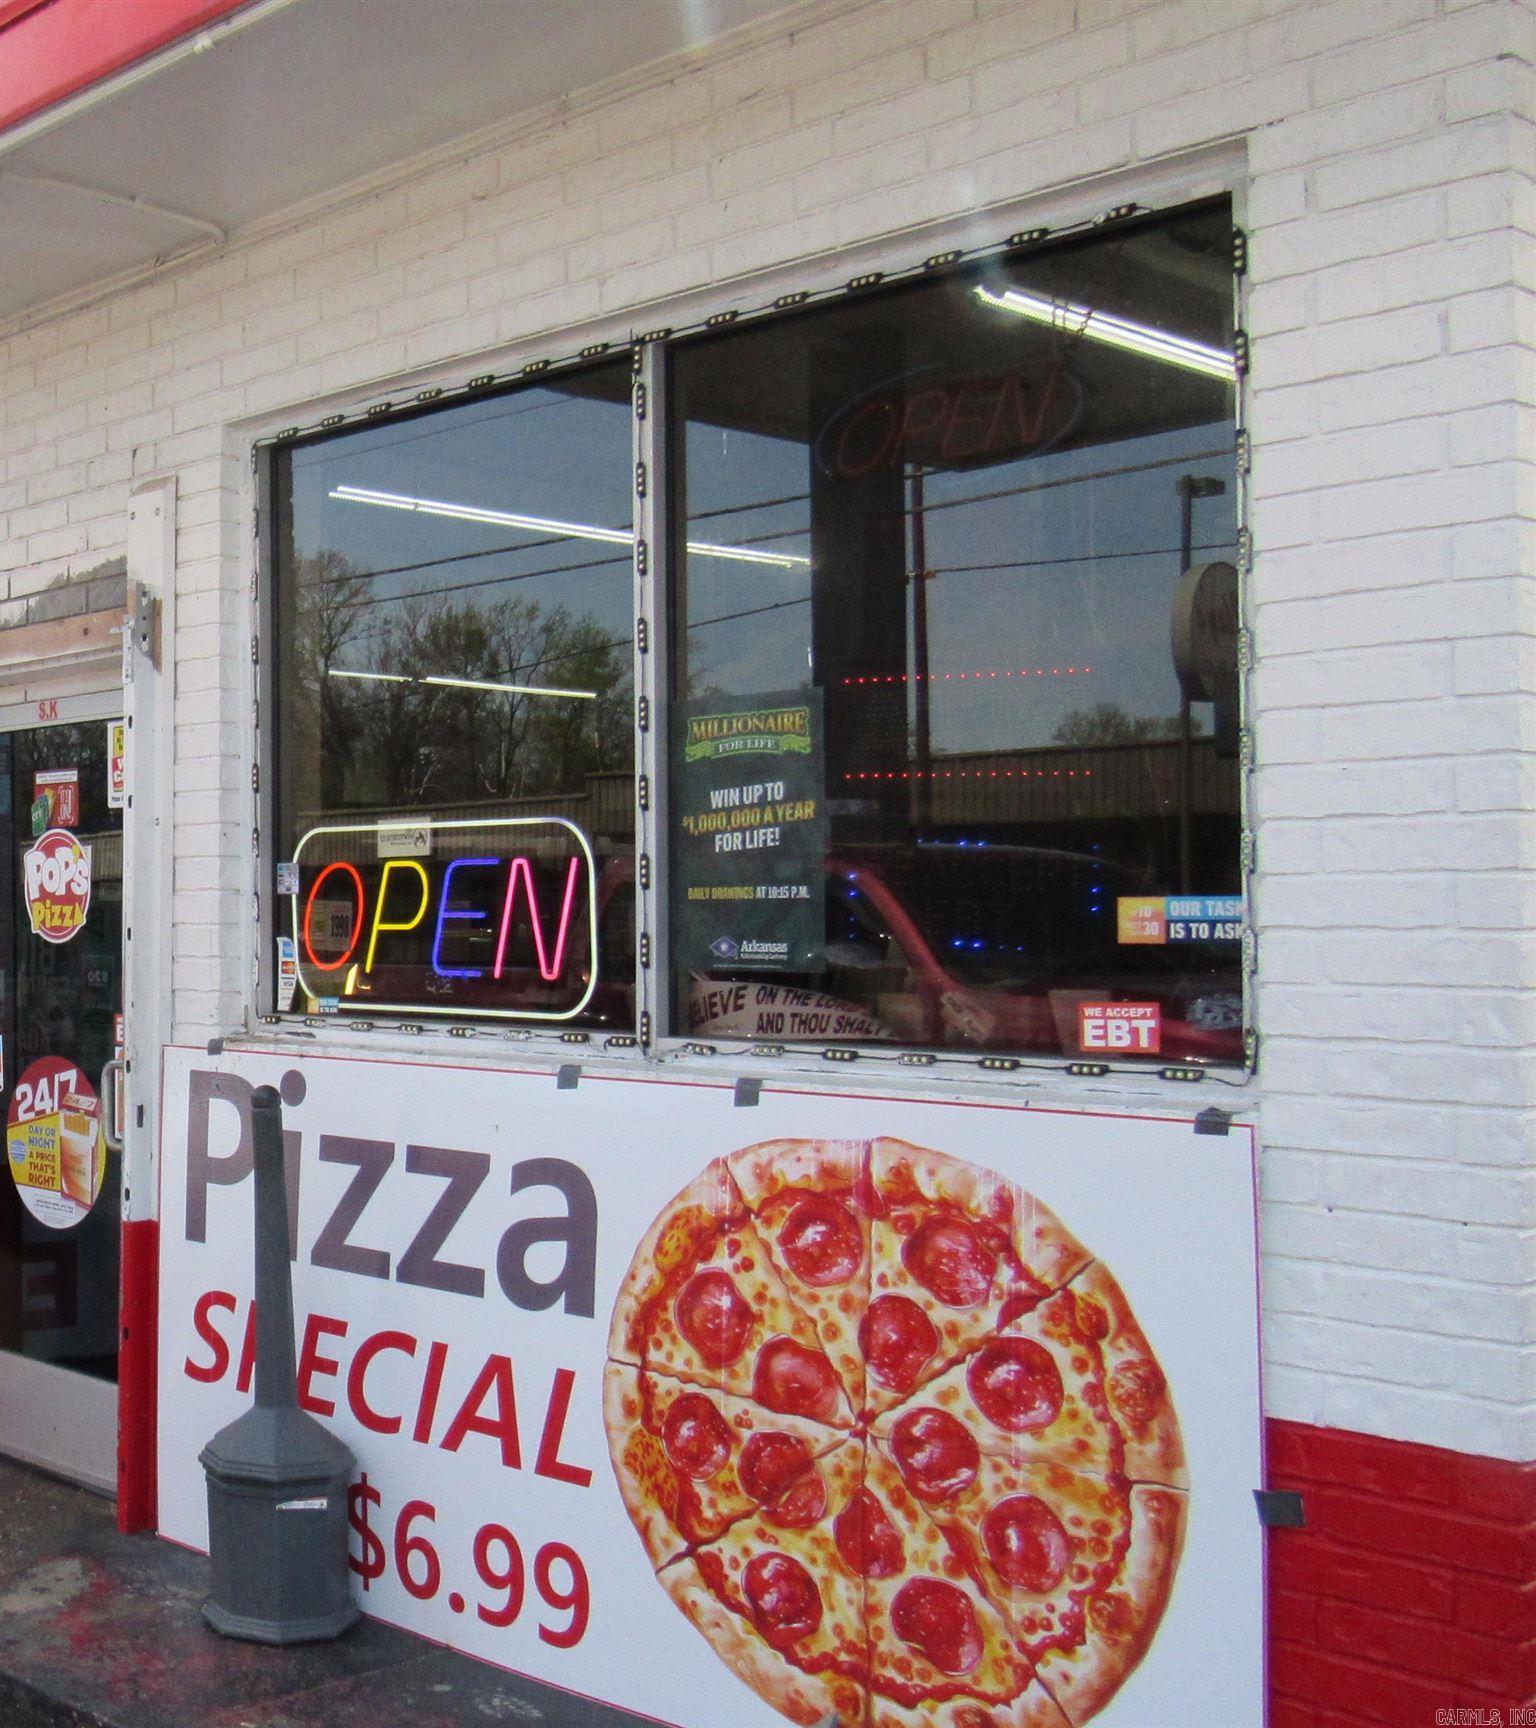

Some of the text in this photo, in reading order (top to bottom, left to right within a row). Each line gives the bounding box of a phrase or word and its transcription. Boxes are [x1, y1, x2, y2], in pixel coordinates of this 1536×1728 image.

[691, 712, 805, 741] MILLIONAIRE
[718, 739, 775, 753] FOR LIFE
[710, 781, 784, 809] WIN UP TO
[682, 800, 816, 836] $1,000,000 A YEAR
[715, 827, 780, 853] FOR LIFE!
[688, 887, 710, 899] DAILY
[712, 886, 755, 899] DRAWINGS
[755, 886, 766, 899] AT
[768, 886, 789, 899] 10:15
[304, 856, 578, 981] OPEN
[1169, 900, 1202, 917] OUR
[1169, 922, 1185, 939] IS
[1189, 922, 1209, 939] TO
[740, 940, 788, 952] Arkansas
[756, 986, 779, 1006] ON
[782, 988, 813, 1007] THE
[1084, 1007, 1153, 1017] WE ACCEPT
[756, 1012, 785, 1034] AND
[790, 1012, 831, 1034] THOU
[1084, 1019, 1156, 1048] EBT
[15, 1069, 77, 1122] 24/7
[28, 1125, 56, 1137] DAY OR
[29, 1137, 56, 1149] NIGHT
[35, 1151, 56, 1163] PRICE
[29, 1162, 56, 1175] THAT'S
[28, 1173, 56, 1187] RIGHT
[185, 1069, 599, 1319] Pizza
[184, 1289, 593, 1488] SECIAL
[348, 1472, 591, 1650] $6.99
